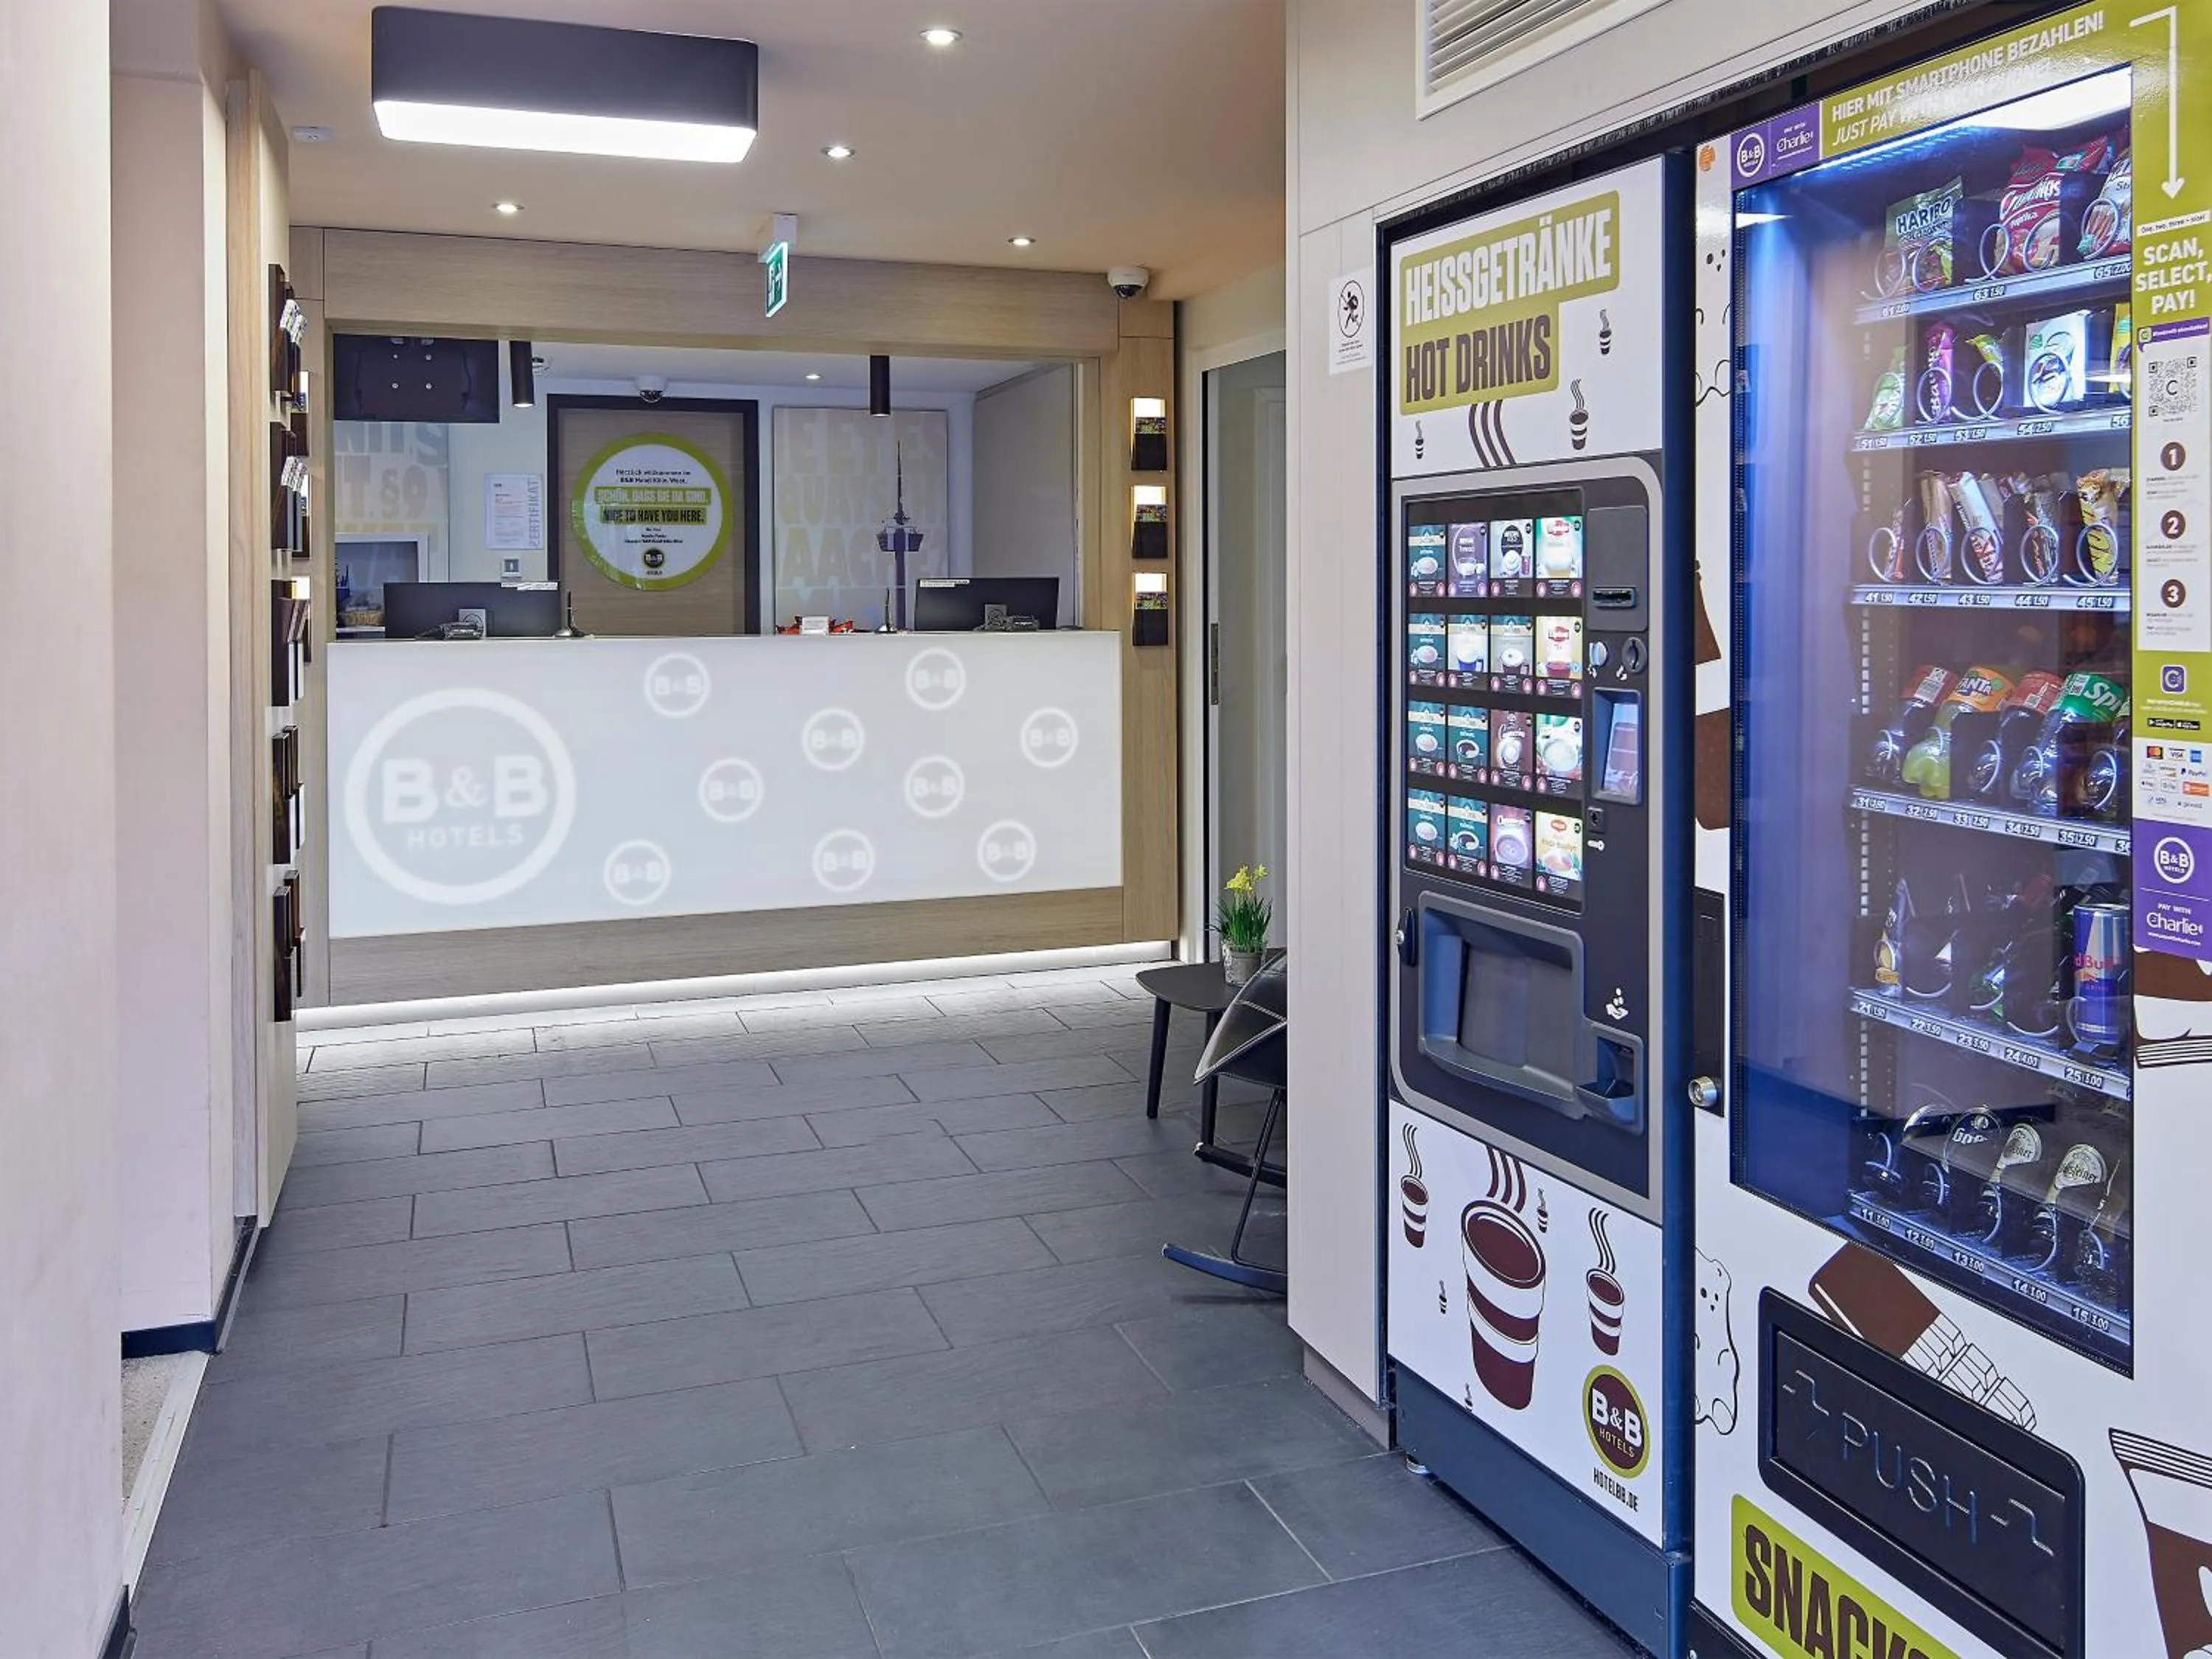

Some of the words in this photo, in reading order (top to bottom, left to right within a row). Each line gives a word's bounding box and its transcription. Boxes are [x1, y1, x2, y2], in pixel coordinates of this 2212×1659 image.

[1832, 97, 1864, 123] HIER
[1866, 86, 1894, 111] MIT
[1896, 45, 2004, 99] SMARTPHONE
[2007, 10, 2104, 63] BEZAHLEN!
[1832, 118, 1869, 146] JUST
[1870, 108, 1898, 133] PAY
[1742, 145, 1761, 163] B&B
[1896, 196, 1952, 235] HARIBO
[2143, 237, 2203, 265] SCAN,
[1406, 208, 1613, 327] HEISSGETRÄNKE
[2135, 261, 2212, 292] SELECT,
[2151, 288, 2195, 316] PAY!
[1405, 337, 1450, 403] HOT
[1455, 313, 1551, 395] DRINKS
[2112, 415, 2129, 427] 56
[2169, 448, 2177, 466] 1
[526, 476, 541, 549] ZERTIFIKAT
[625, 509, 636, 521] TO
[638, 509, 660, 522] HAVE
[661, 509, 678, 522] YOU
[680, 509, 705, 522] HERE.
[2167, 516, 2179, 535] 2
[1958, 595, 1974, 605] 43
[2016, 596, 2032, 605] 44
[2078, 597, 2095, 607] 45
[2168, 584, 2180, 604] 3
[654, 674, 702, 697] B&B
[914, 667, 958, 690] B&B
[810, 728, 856, 751] B&B
[1029, 727, 1071, 748] B&B
[382, 754, 548, 824] B&B
[709, 778, 755, 801] B&B
[913, 775, 957, 799] B&B
[407, 823, 525, 849] HOTELS
[2006, 823, 2021, 834] 34
[2059, 830, 2075, 843] 35
[822, 849, 867, 873] B&B
[986, 840, 1029, 863] B&B
[2160, 850, 2189, 868] B&B
[613, 861, 664, 884] B&B
[2157, 902, 2171, 911] PAY
[2173, 905, 2191, 915] WITH
[2066, 1068, 2082, 1082] 25
[2013, 1279, 2029, 1293] 14
[2073, 1307, 2090, 1322] 15
[1593, 1388, 1642, 1447] B&B
[1599, 1427, 1635, 1458] HOTELS
[1842, 1410, 1978, 1544] PUSH
[1593, 1467, 1638, 1512] HOTELBB.DE
